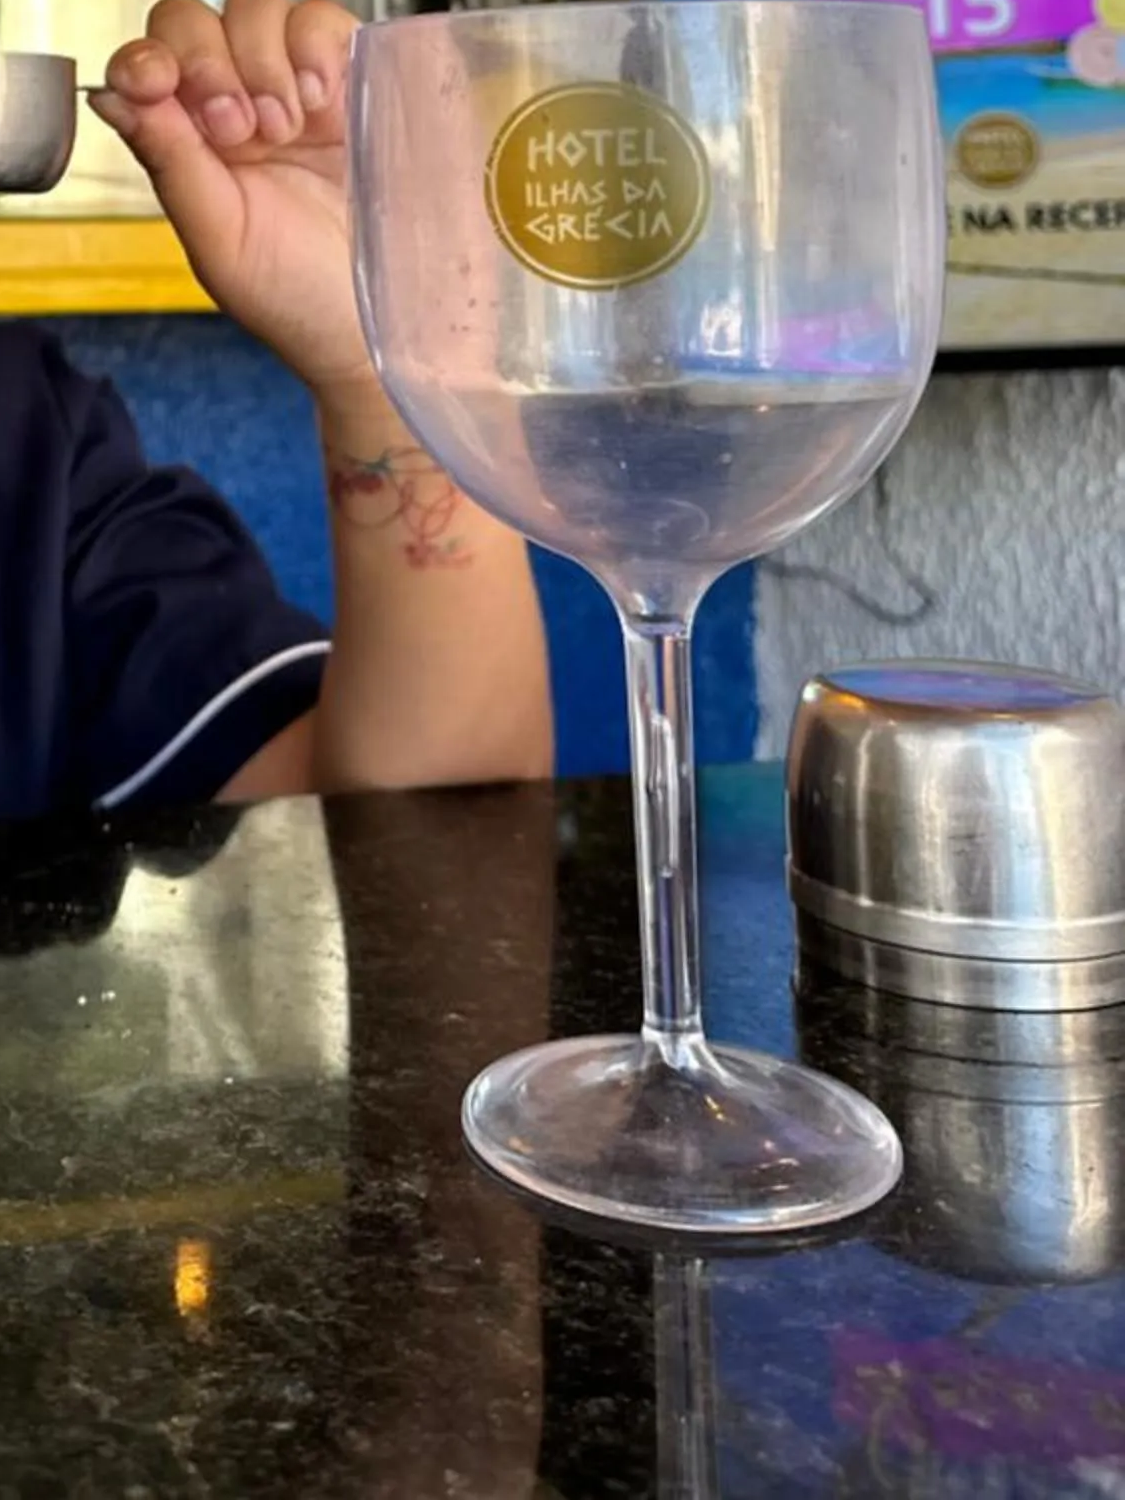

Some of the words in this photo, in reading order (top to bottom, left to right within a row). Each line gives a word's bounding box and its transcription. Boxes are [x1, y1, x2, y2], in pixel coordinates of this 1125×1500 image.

[527, 127, 668, 172] HOTEL
[525, 179, 607, 208] ILHAS
[622, 176, 667, 203] DA
[524, 205, 673, 245] GRÉCIA
[962, 204, 1016, 236] NA
